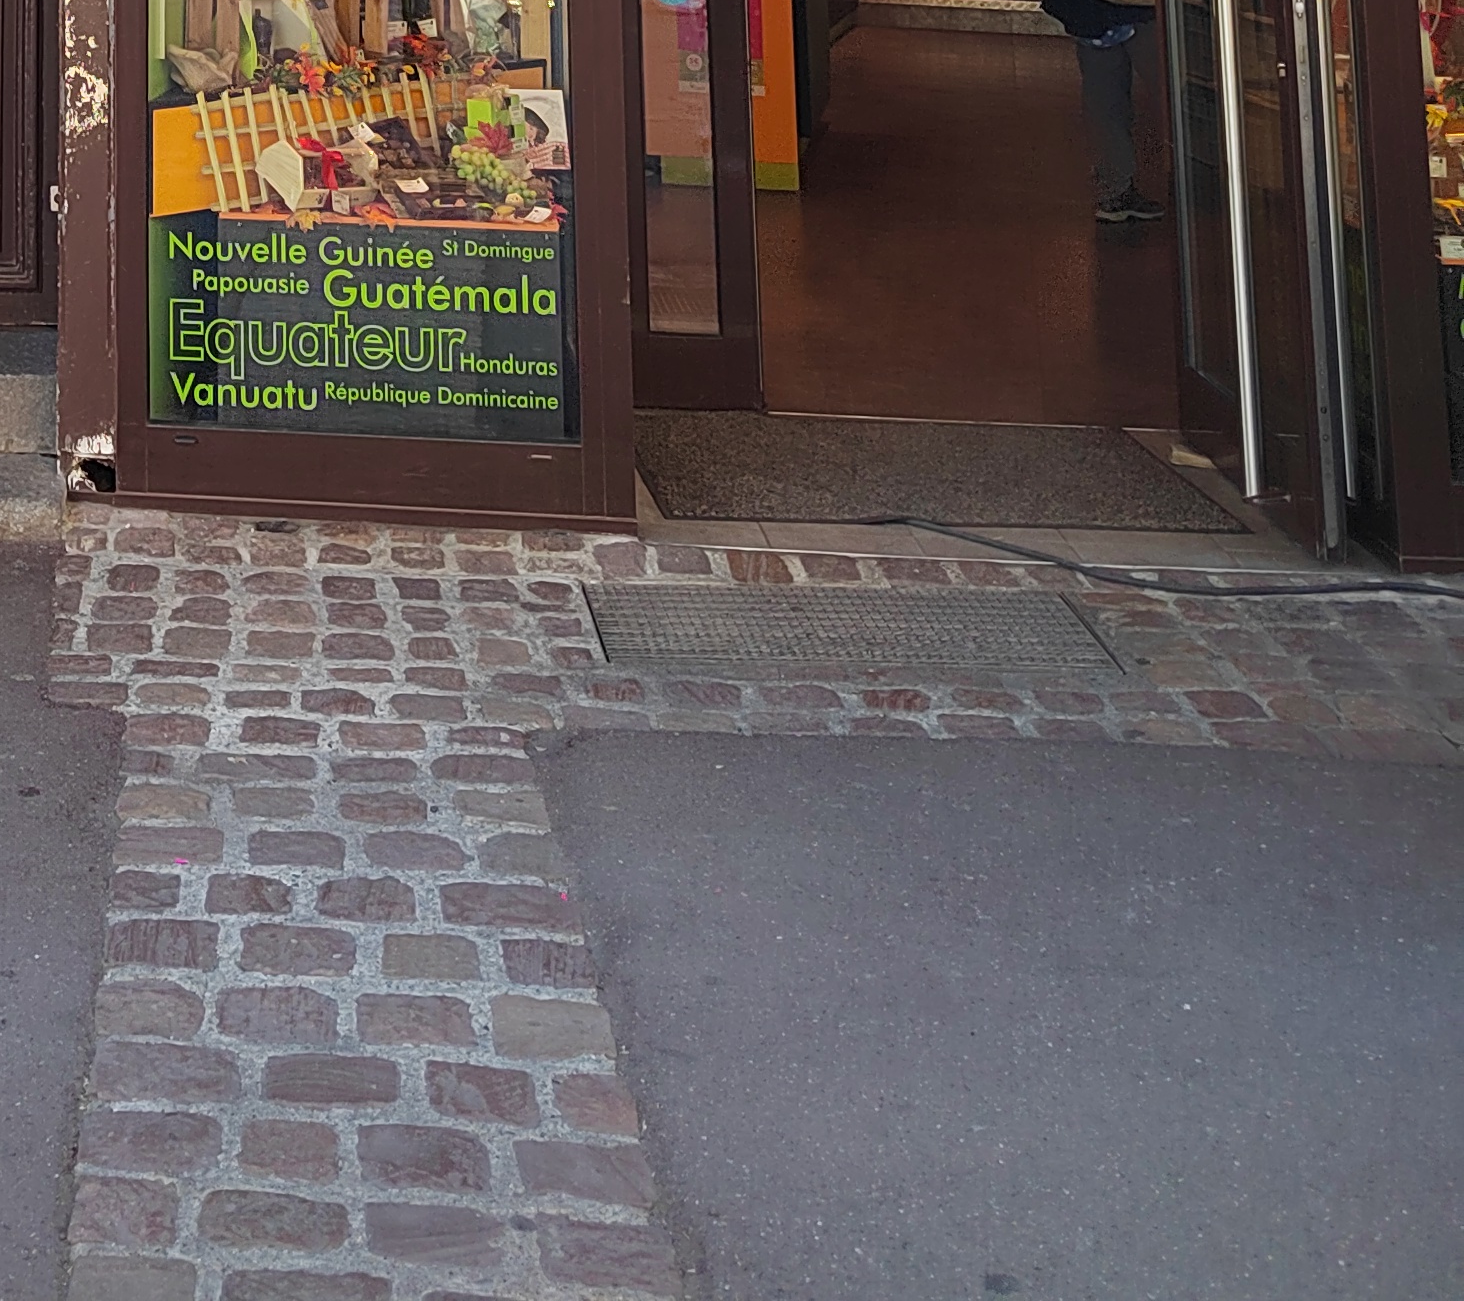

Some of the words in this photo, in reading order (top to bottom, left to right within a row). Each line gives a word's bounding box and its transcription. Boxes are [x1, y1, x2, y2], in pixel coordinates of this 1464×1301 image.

[168, 231, 307, 264] Nouvelle
[319, 237, 434, 268] Guinée
[442, 239, 458, 256] St
[465, 240, 554, 262] Domingue
[192, 269, 309, 297] Papouasie
[324, 269, 557, 316] Guatémala
[169, 298, 467, 381] Equateur
[461, 353, 557, 376] Honduras
[170, 372, 317, 411] Vanuatu
[325, 382, 430, 407] République
[438, 387, 558, 410] Dominicaine
